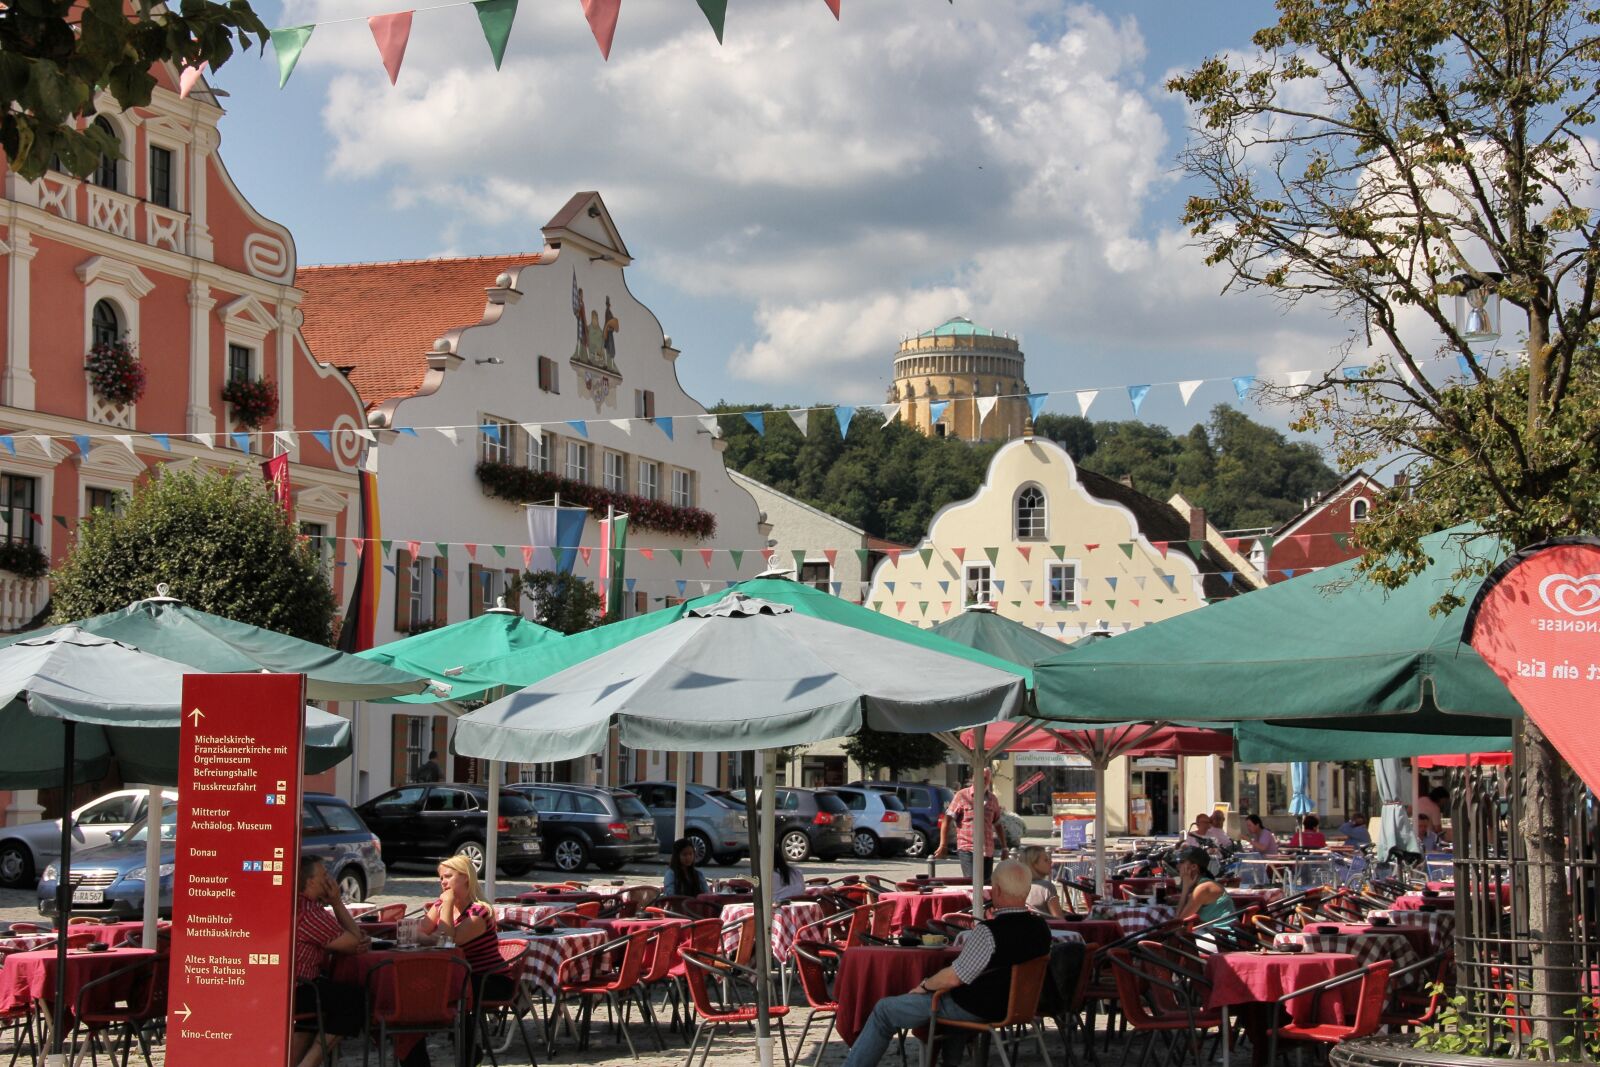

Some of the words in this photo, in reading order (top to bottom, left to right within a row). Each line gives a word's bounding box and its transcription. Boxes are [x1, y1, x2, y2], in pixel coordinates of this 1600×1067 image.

[195, 735, 256, 744] Michaelskirche
[194, 745, 272, 754] Franziskanerkirche
[274, 745, 288, 754] mit
[194, 755, 251, 765] Orgelmuseum
[193, 768, 258, 779] Befreiungshalle
[193, 782, 257, 792] Flusskreuzfahrt
[191, 808, 231, 817] Mittertor
[191, 821, 235, 831] Archäolog.
[237, 821, 272, 831] Museum
[190, 848, 217, 857] Donau
[189, 874, 229, 884] Donautor
[188, 888, 236, 898] Ottokapelle
[186, 914, 233, 924] Altmühltor
[186, 928, 251, 938] Matthäuskirche
[184, 955, 206, 964] Altes
[208, 956, 242, 965] Rathaus
[184, 965, 210, 975] Neues
[212, 966, 246, 975] Rathaus
[195, 976, 245, 986] Tourist-Info
[181, 1029, 233, 1040] Kino-Center
